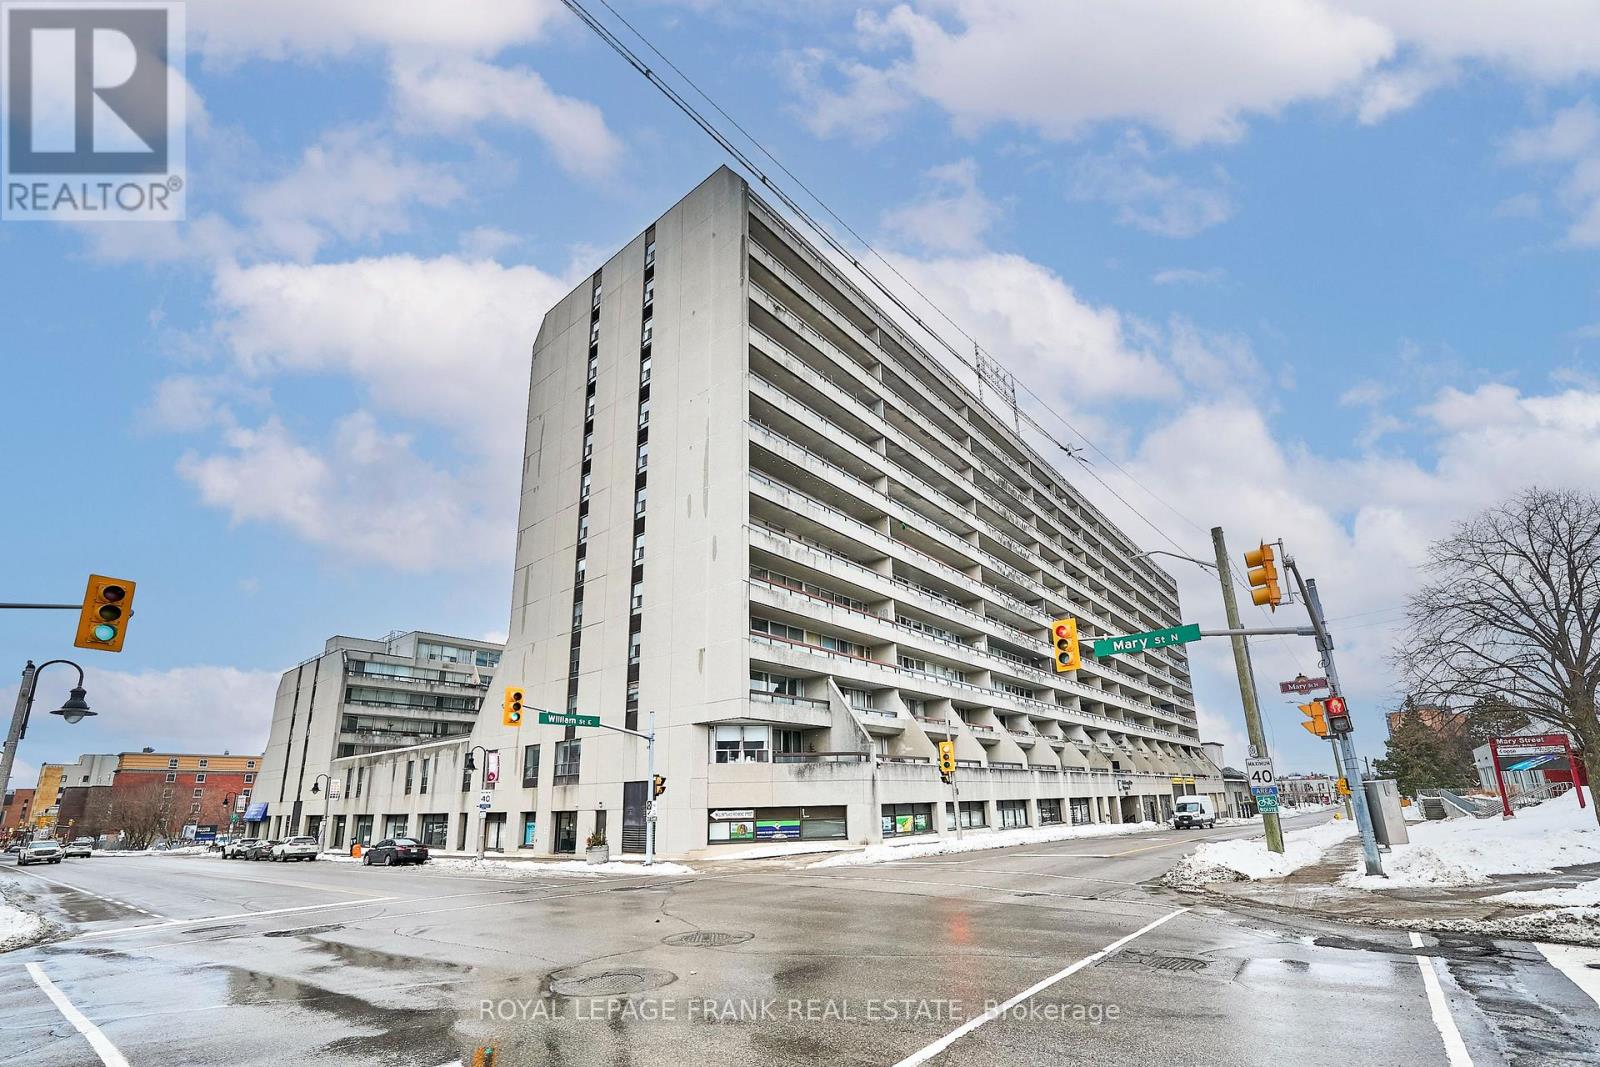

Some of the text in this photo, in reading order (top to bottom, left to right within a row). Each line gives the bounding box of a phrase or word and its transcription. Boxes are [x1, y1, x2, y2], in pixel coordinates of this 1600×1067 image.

[1113, 633, 1179, 651] Mary St N
[1288, 682, 1307, 690] Mary
[548, 714, 577, 724] William
[1251, 769, 1273, 783] 40
